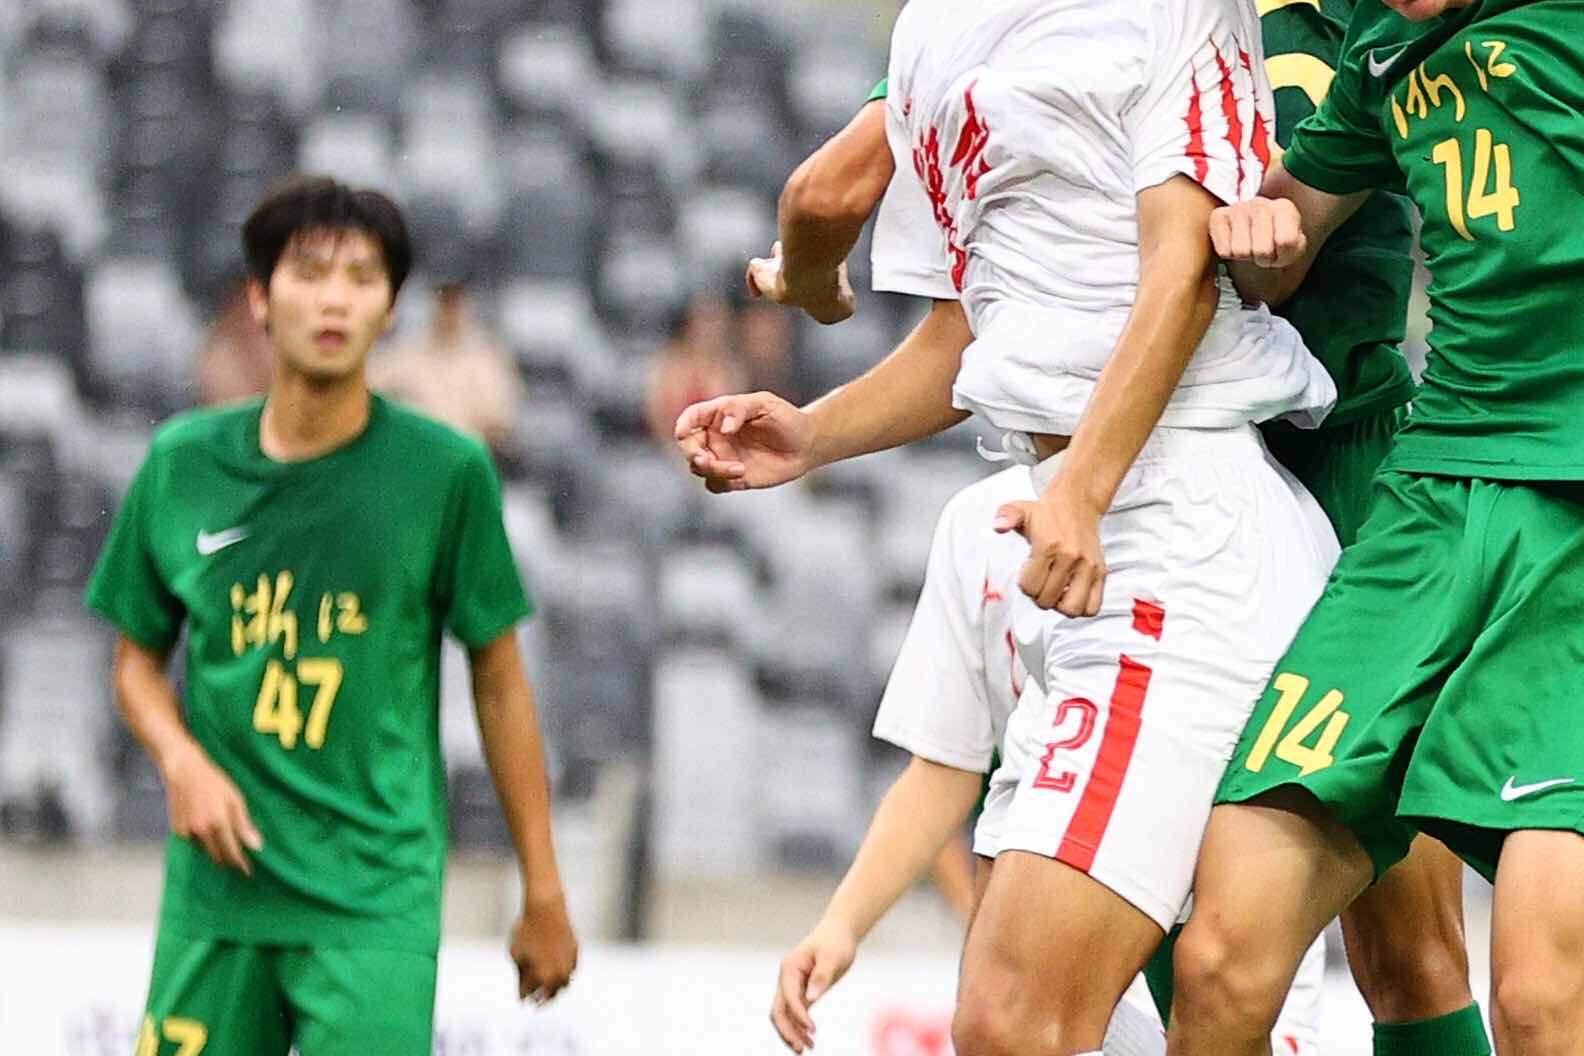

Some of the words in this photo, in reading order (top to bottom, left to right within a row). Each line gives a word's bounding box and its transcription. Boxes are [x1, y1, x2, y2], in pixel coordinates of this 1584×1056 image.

[1432, 128, 1520, 241] 14
[253, 657, 344, 750] 47
[1033, 696, 1098, 793] 2
[1245, 672, 1350, 777] 14
